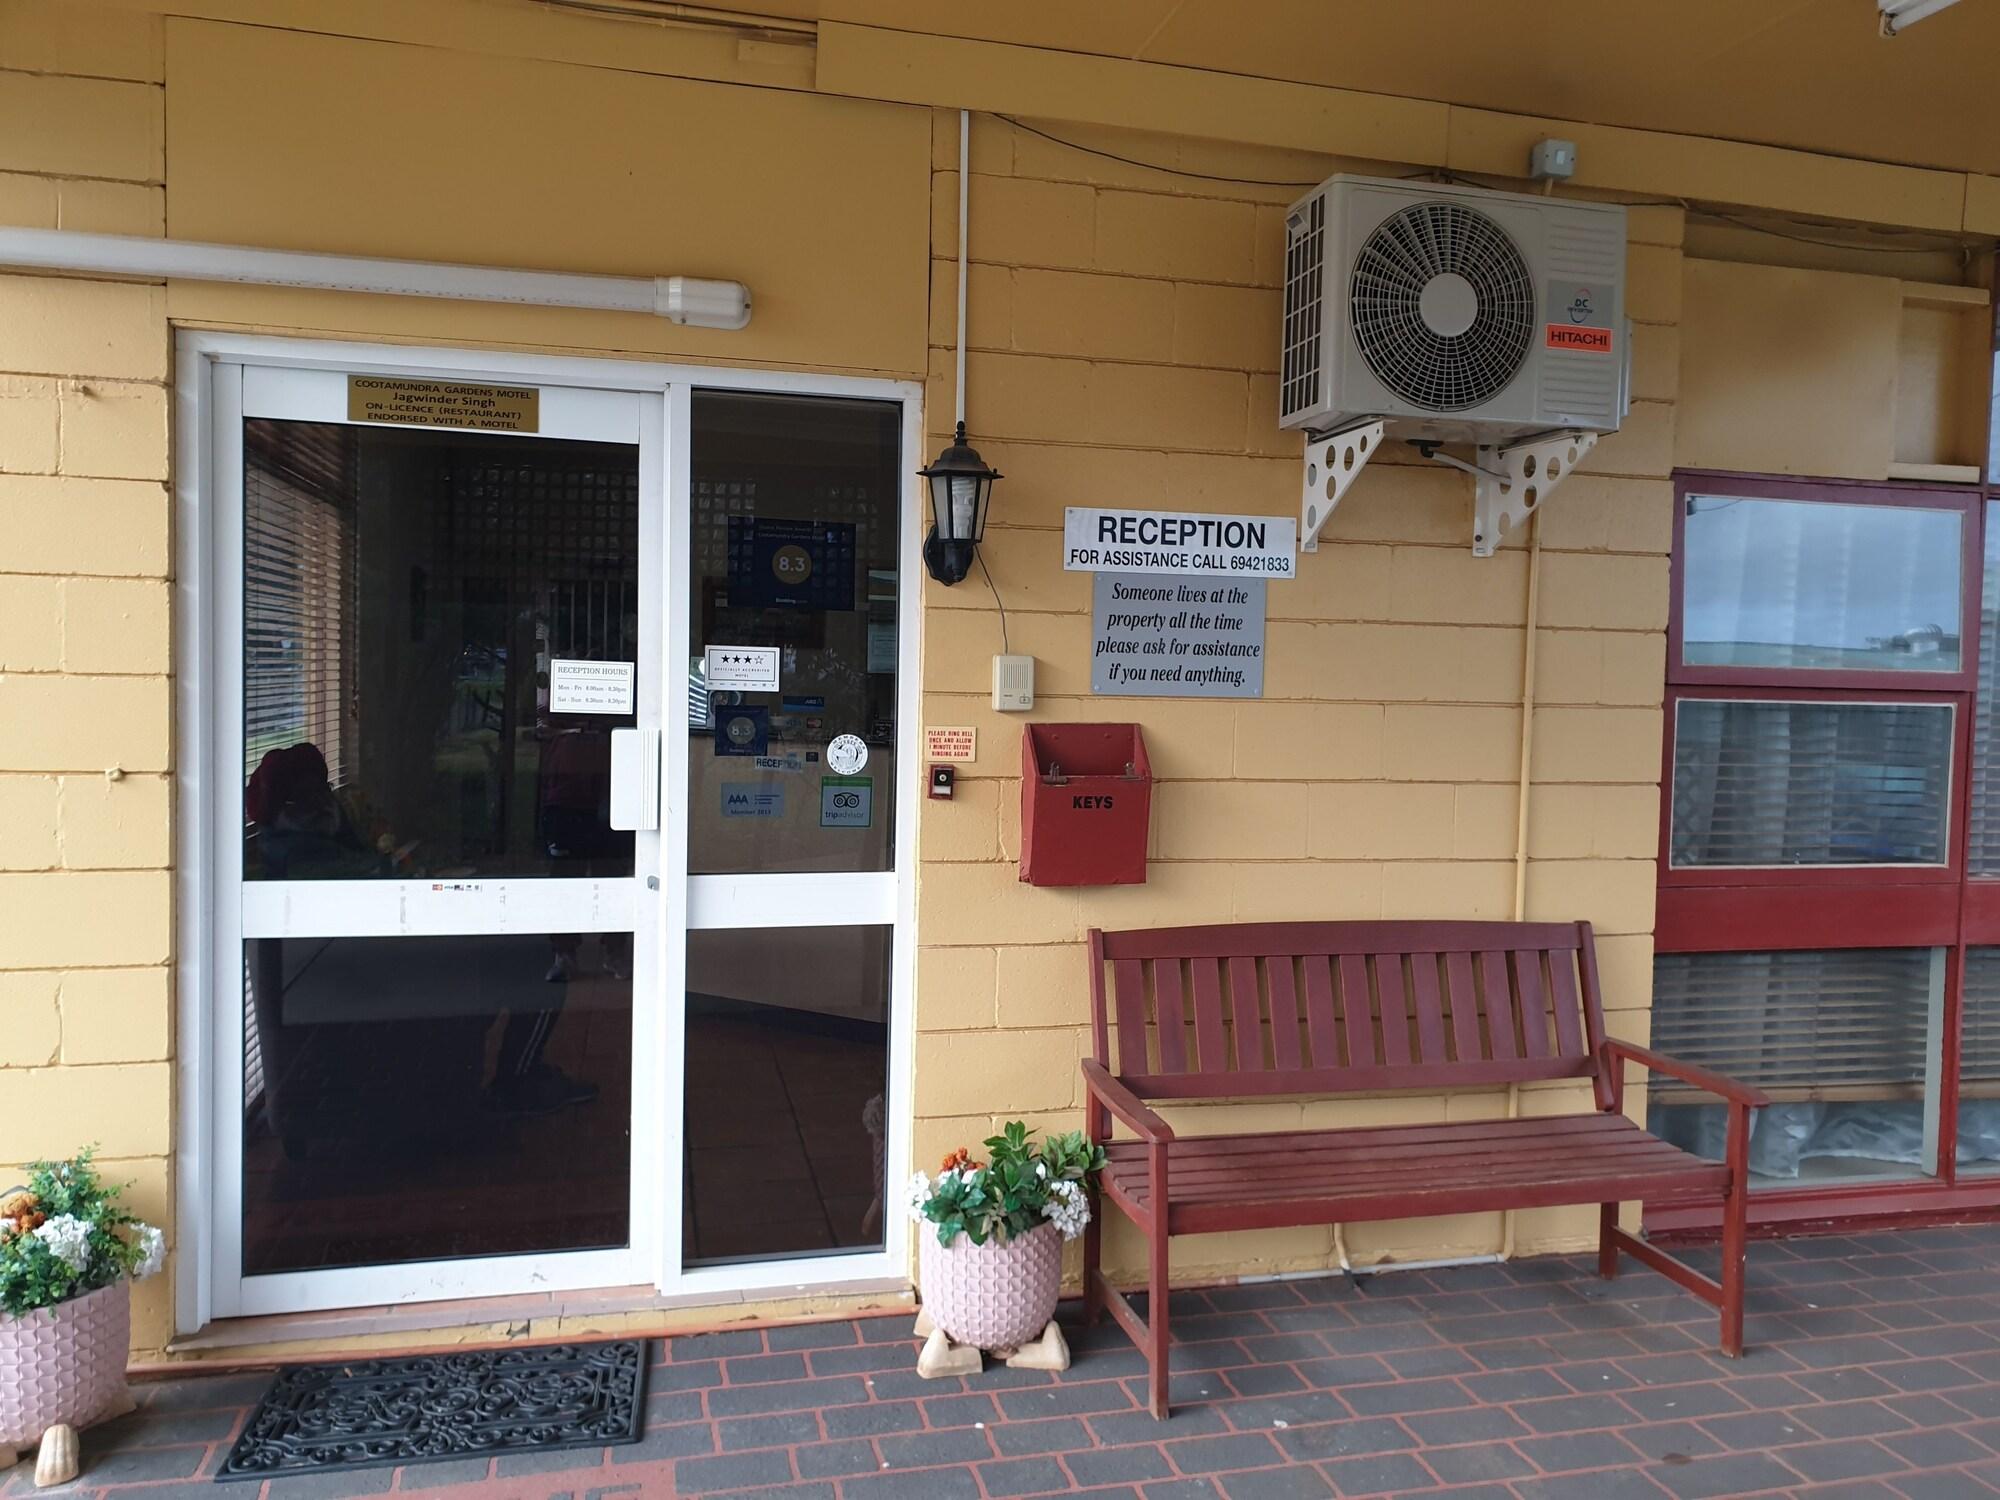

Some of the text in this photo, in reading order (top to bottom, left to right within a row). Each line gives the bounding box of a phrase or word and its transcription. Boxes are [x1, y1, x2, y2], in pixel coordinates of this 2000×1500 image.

[1575, 298, 1589, 308] DC
[1551, 331, 1608, 346] HITACHI
[355, 379, 532, 400] COOTAMUNDRA GARDENS MOTEL
[392, 392, 496, 408] Jagwinder Singh
[365, 402, 521, 420] ON-LICENCE (RESTAURANT)
[367, 412, 519, 430] ENDORSED WITH A MOTEL
[1098, 515, 1266, 549] RECEPTION
[778, 556, 805, 572] 8.3
[1070, 549, 1290, 572] FOR ASSISTANCE CALL 69421833
[1112, 582, 1249, 604] Someone lives at the
[1106, 612, 1243, 632] property all the time
[1096, 636, 1260, 658] please ask for assistance
[558, 666, 600, 675] RECEPTION
[1108, 663, 1246, 687] if you need anything.
[731, 725, 752, 736] 8.3
[728, 793, 748, 805] AAA
[1072, 795, 1113, 809] KEYS
[825, 811, 864, 820] tripadvisor
